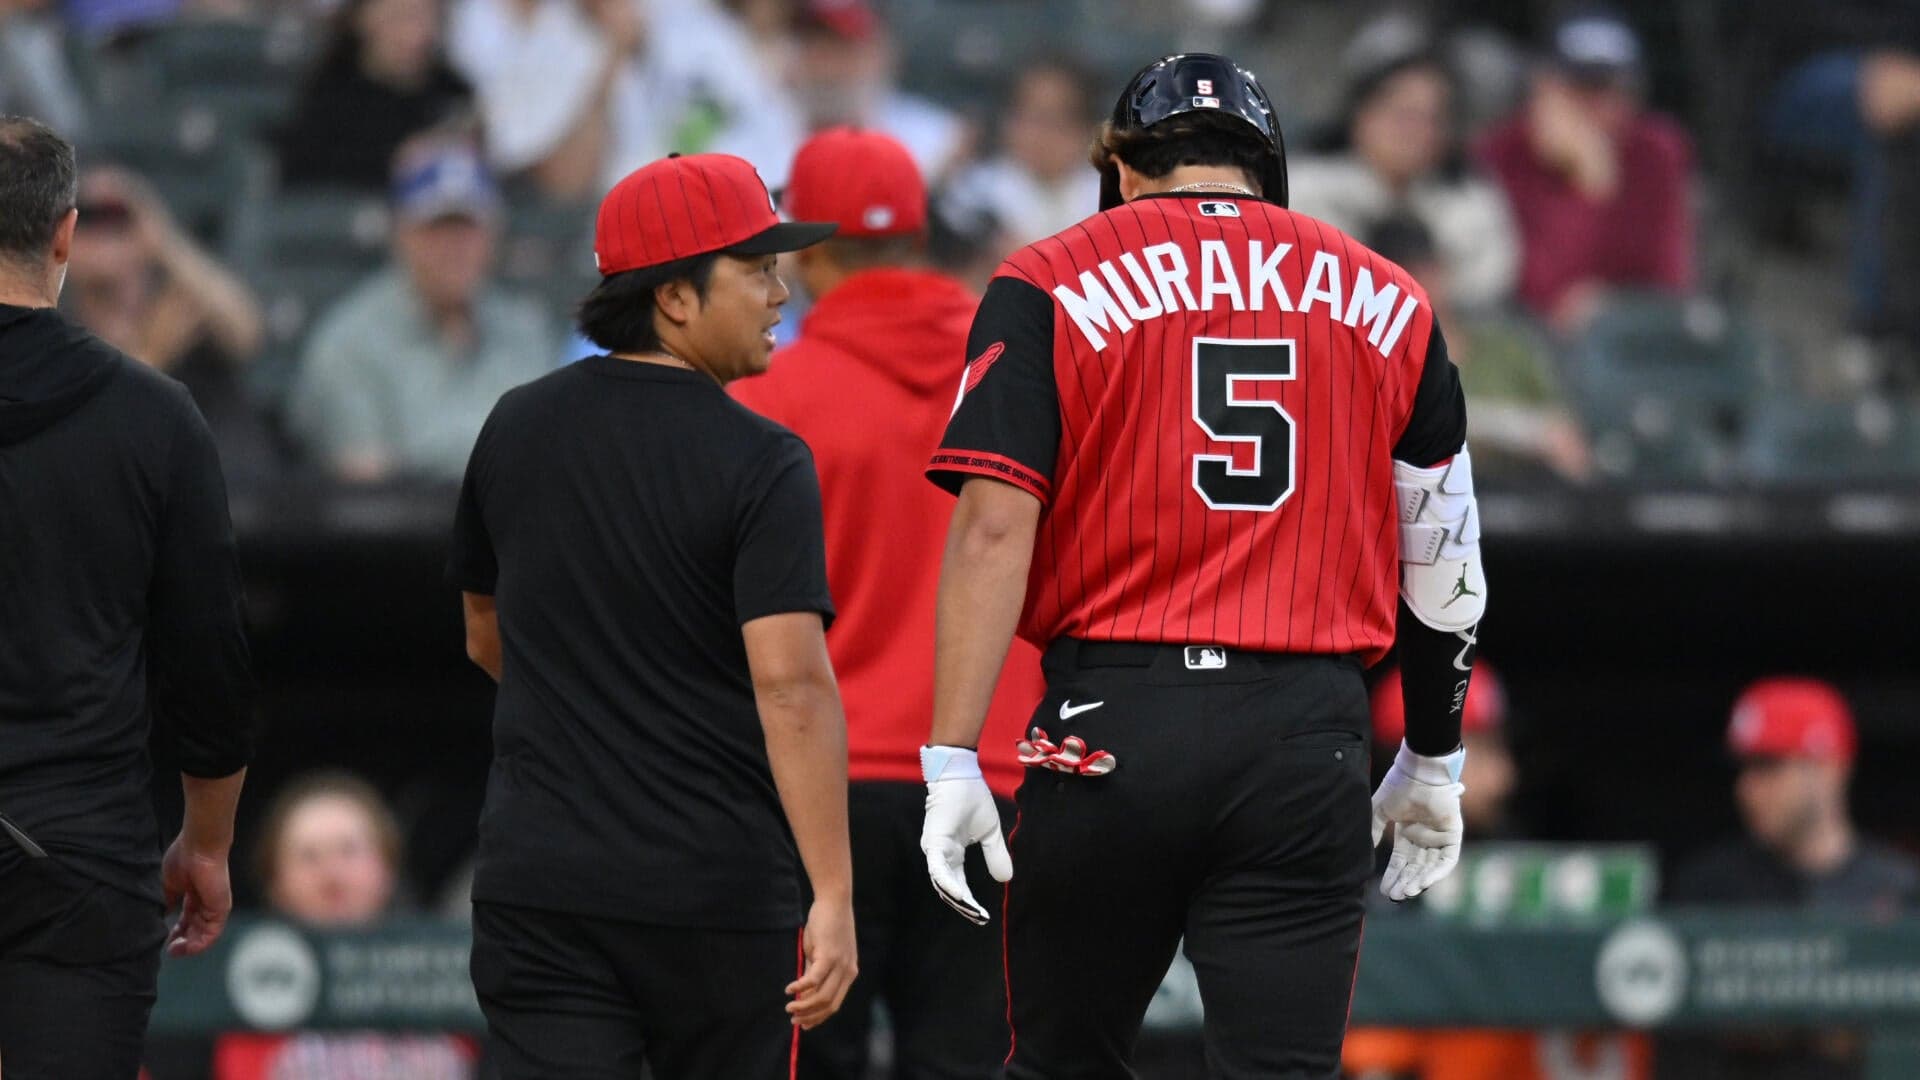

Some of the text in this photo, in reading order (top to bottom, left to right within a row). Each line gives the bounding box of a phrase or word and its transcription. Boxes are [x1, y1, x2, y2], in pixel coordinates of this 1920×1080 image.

[1197, 79, 1213, 95] 5
[1052, 239, 1418, 358] MURAKAMI
[1192, 337, 1296, 512] 5
[971, 458, 1012, 475] SOUTHSIDE
